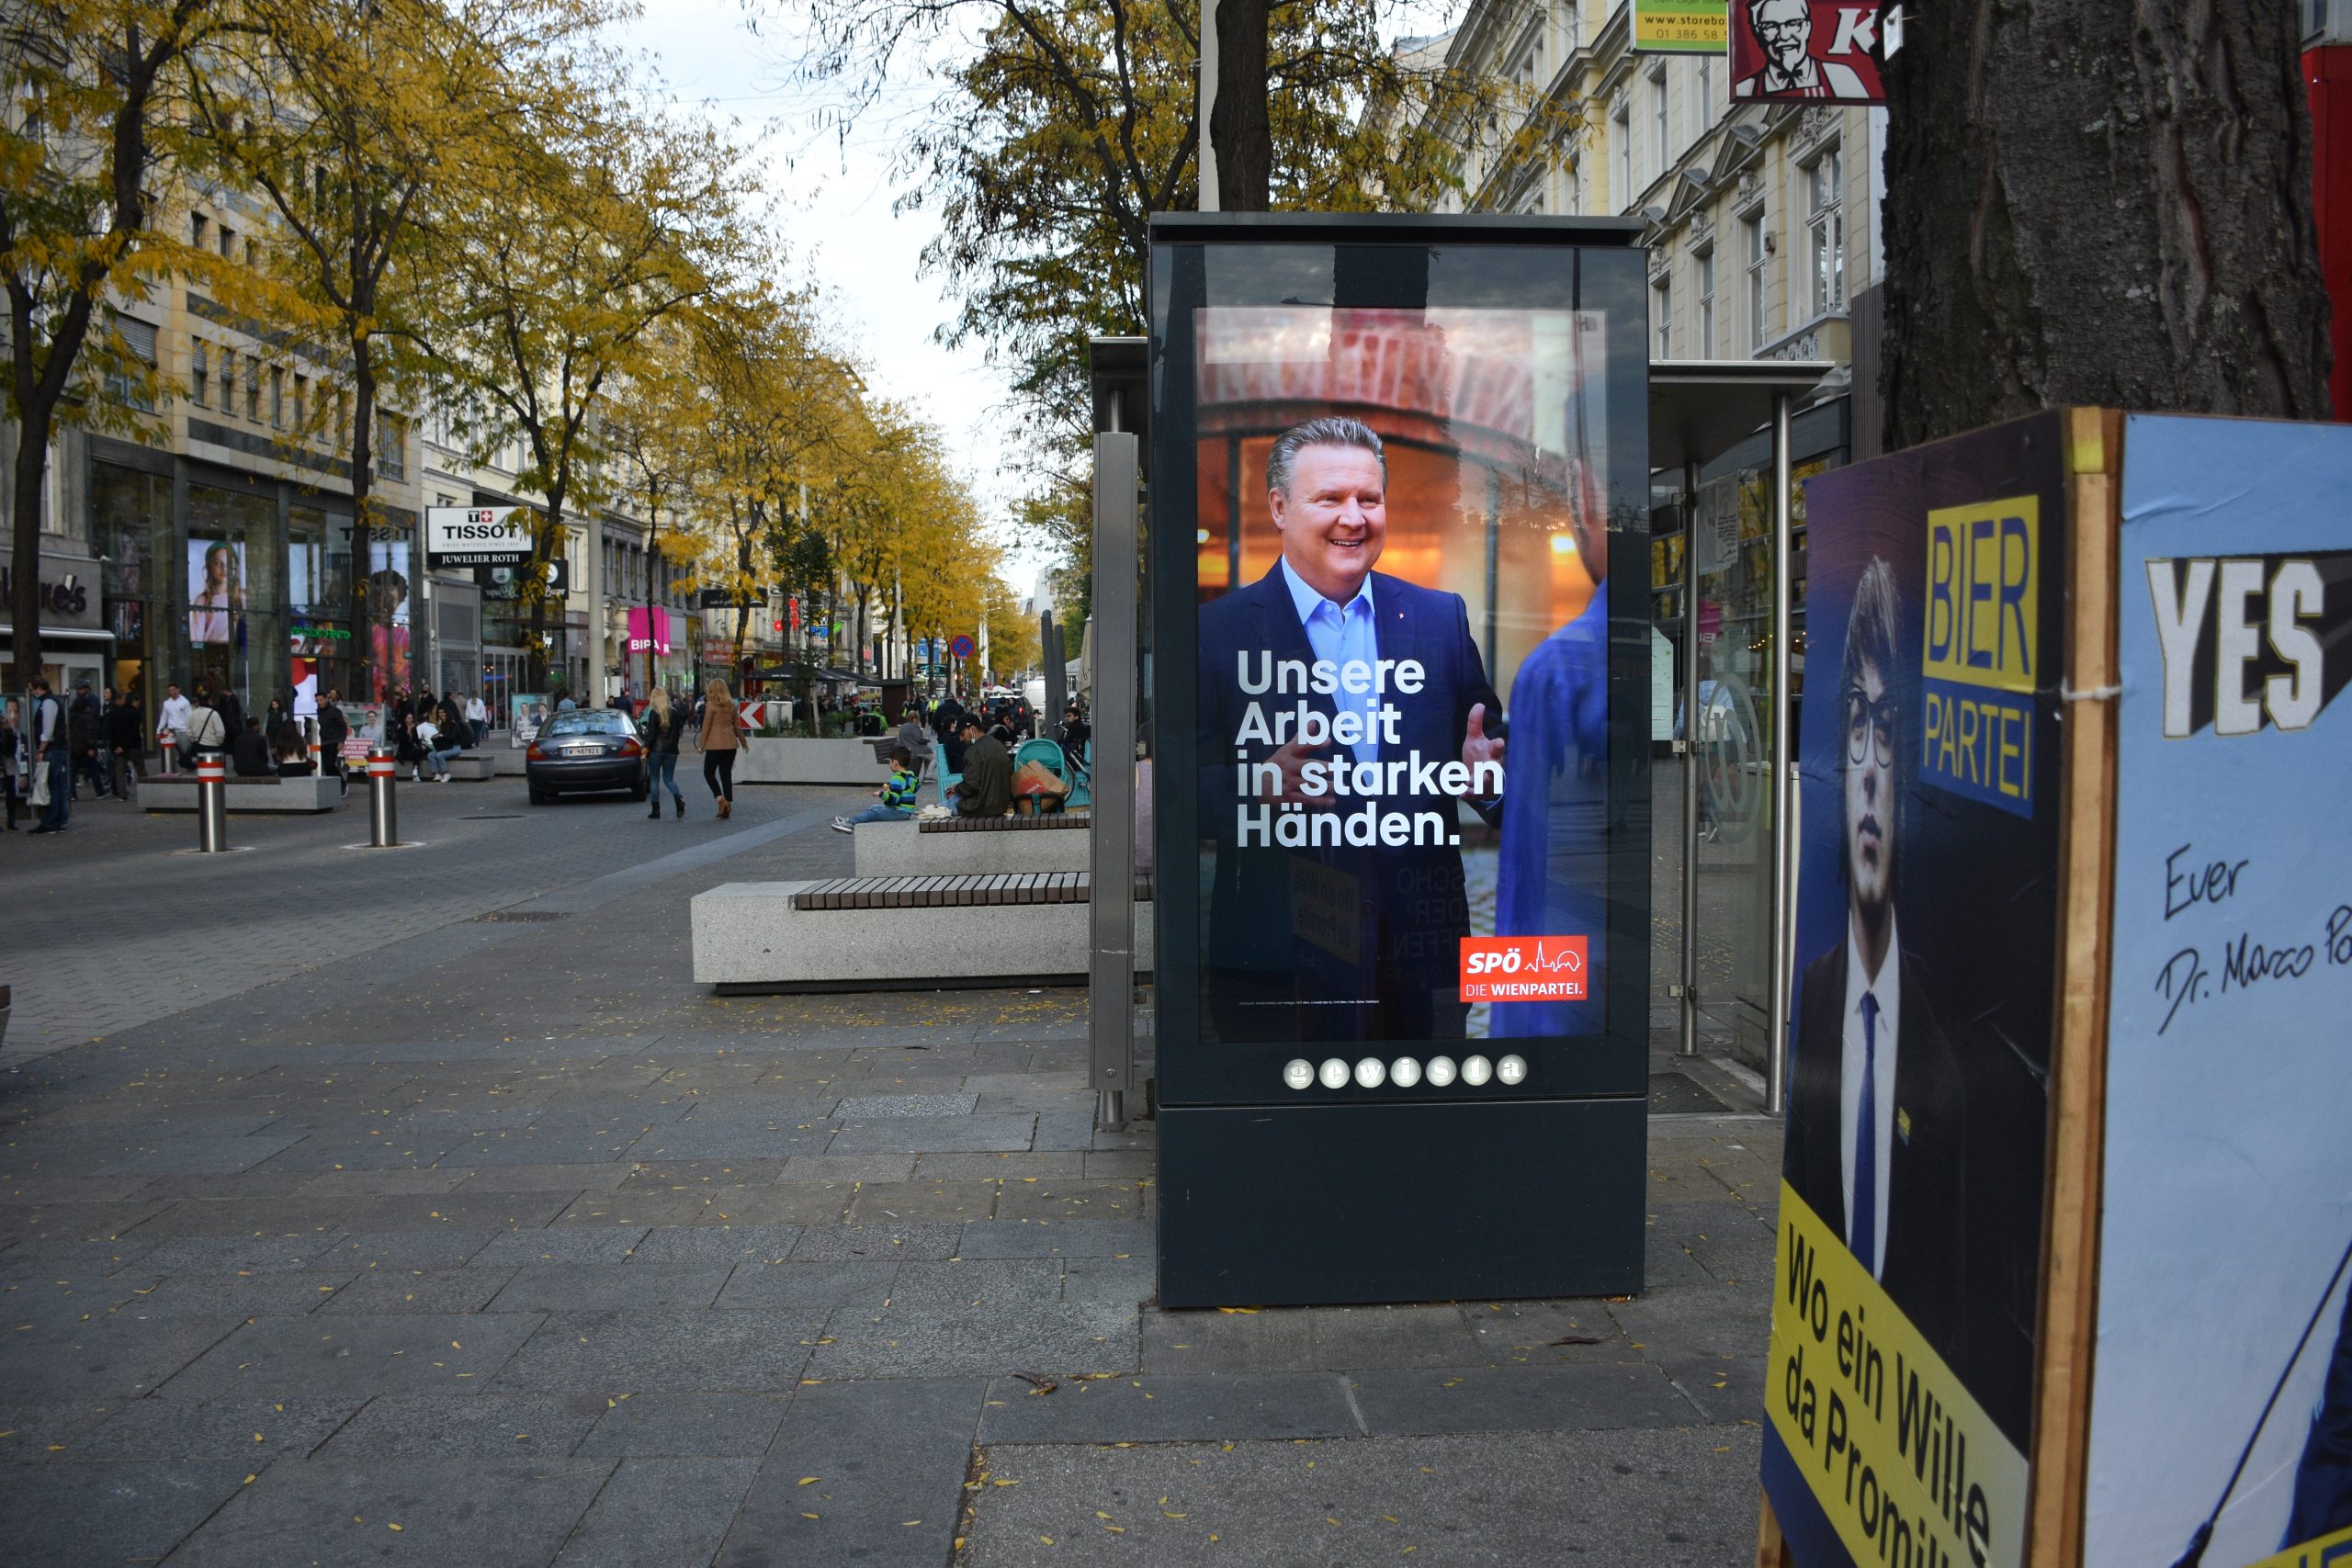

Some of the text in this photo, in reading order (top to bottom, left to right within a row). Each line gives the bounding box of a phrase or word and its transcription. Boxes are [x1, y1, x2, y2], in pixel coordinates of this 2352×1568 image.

[1645, 16, 1727, 26] www.storebo
[1656, 28, 1669, 39] 01
[1676, 29, 1698, 39] 386
[1703, 29, 1718, 39] 58
[442, 525, 518, 539] TISSOT
[442, 554, 519, 565] JUWELIER ROTH
[1928, 516, 2030, 676] BIER
[1237, 650, 1426, 694] Unsere
[2144, 558, 2324, 739] YES
[1234, 699, 1402, 746] Arbeit
[1924, 693, 2030, 800] PARTEI
[1237, 749, 1504, 796] in starken
[1237, 801, 1460, 848] Händen.
[1466, 947, 1521, 974] SPÖ
[2154, 948, 2209, 1035] Dr.
[2222, 932, 2313, 993] Marco
[1465, 982, 1583, 997] DIE WIENPARTEI.
[1287, 1055, 1524, 1087] gewista
[1785, 1343, 1816, 1449] da
[1789, 1221, 1991, 1568] Wo ein Wille
